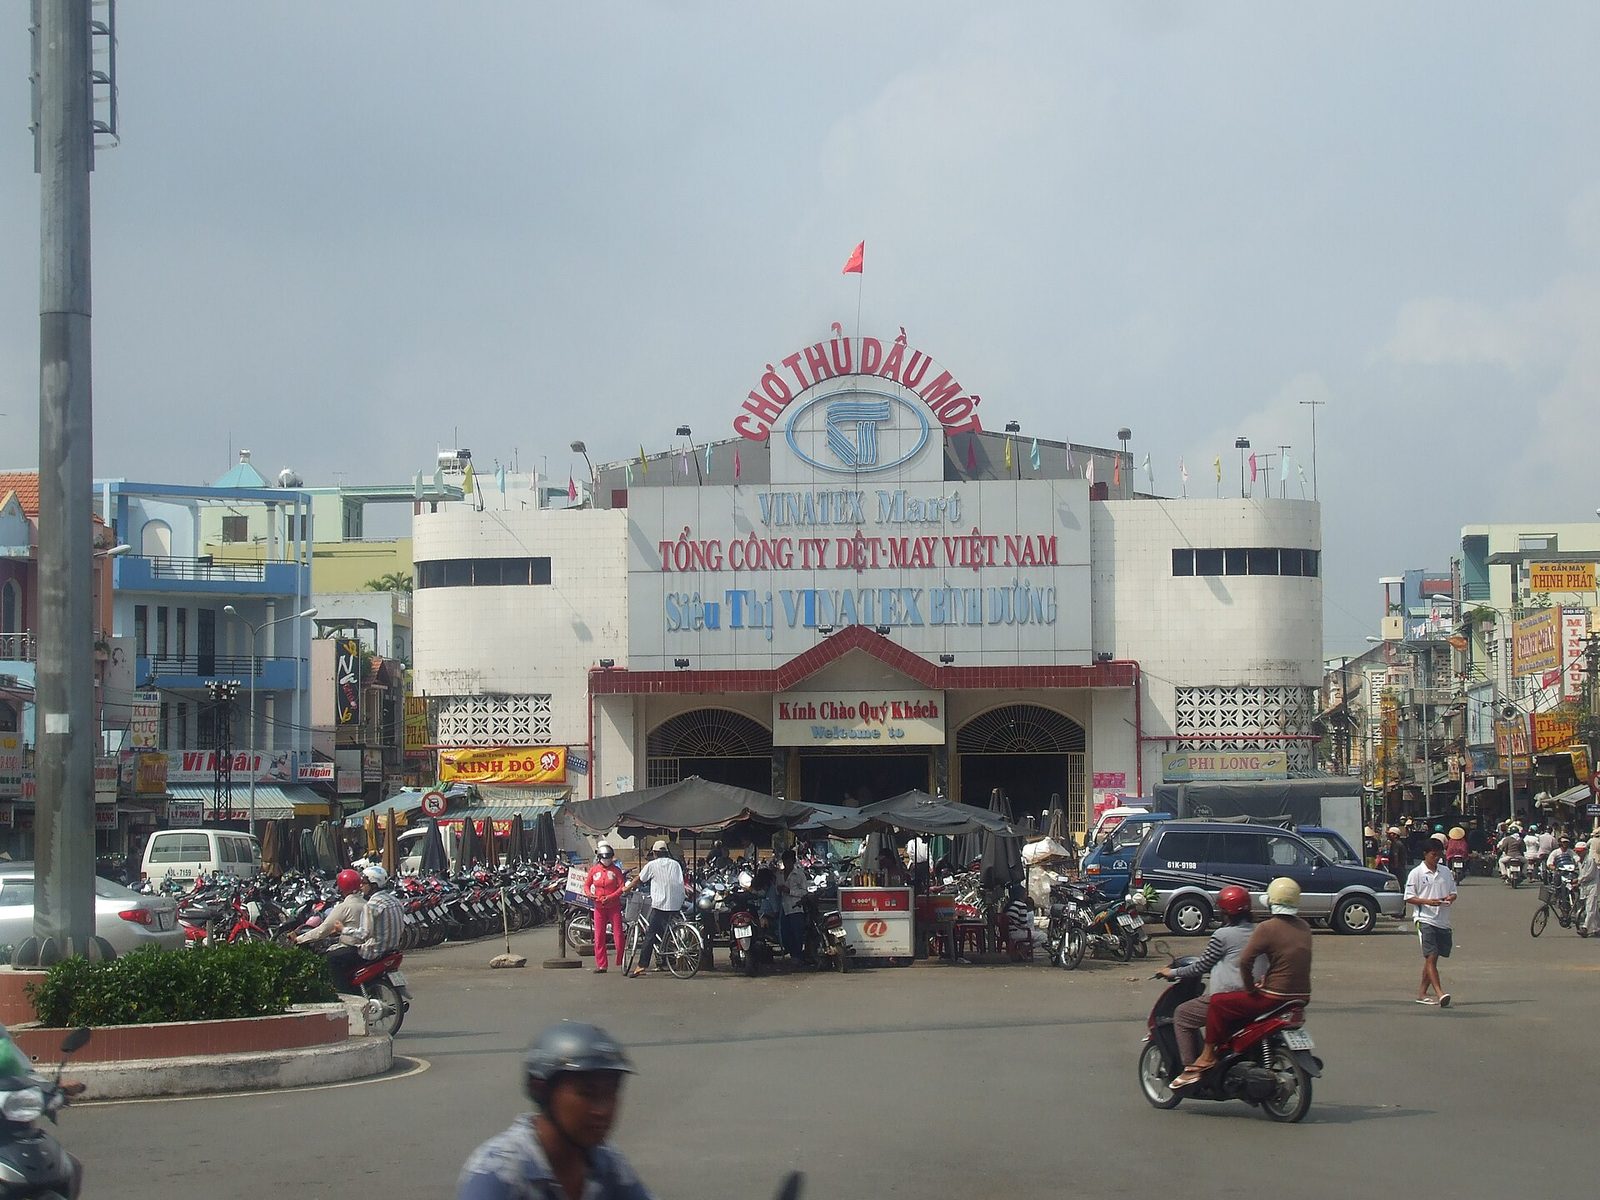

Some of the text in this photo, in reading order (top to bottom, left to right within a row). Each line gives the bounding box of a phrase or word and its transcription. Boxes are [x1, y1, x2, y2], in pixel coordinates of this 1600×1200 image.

[757, 489, 961, 525] VINATEX Mart
[659, 526, 723, 572] TỔNG
[729, 531, 793, 571] CÔNG
[799, 538, 830, 570] TY
[942, 526, 999, 571] VIỆT
[1004, 535, 1058, 566] NAM
[1568, 564, 1586, 572] MÁY
[1533, 571, 1594, 590] THỊNH PHÁT
[666, 591, 722, 632] Siêu
[725, 588, 774, 641] Thị
[779, 588, 925, 628] VINATEX
[929, 579, 983, 625] BÌNH
[779, 699, 939, 725] Kính Chào Quý Khách
[810, 725, 905, 740] Welcome to
[456, 756, 535, 774] KINH ĐÔ
[1188, 757, 1215, 770] PHI
[1219, 757, 1261, 771] LONG
